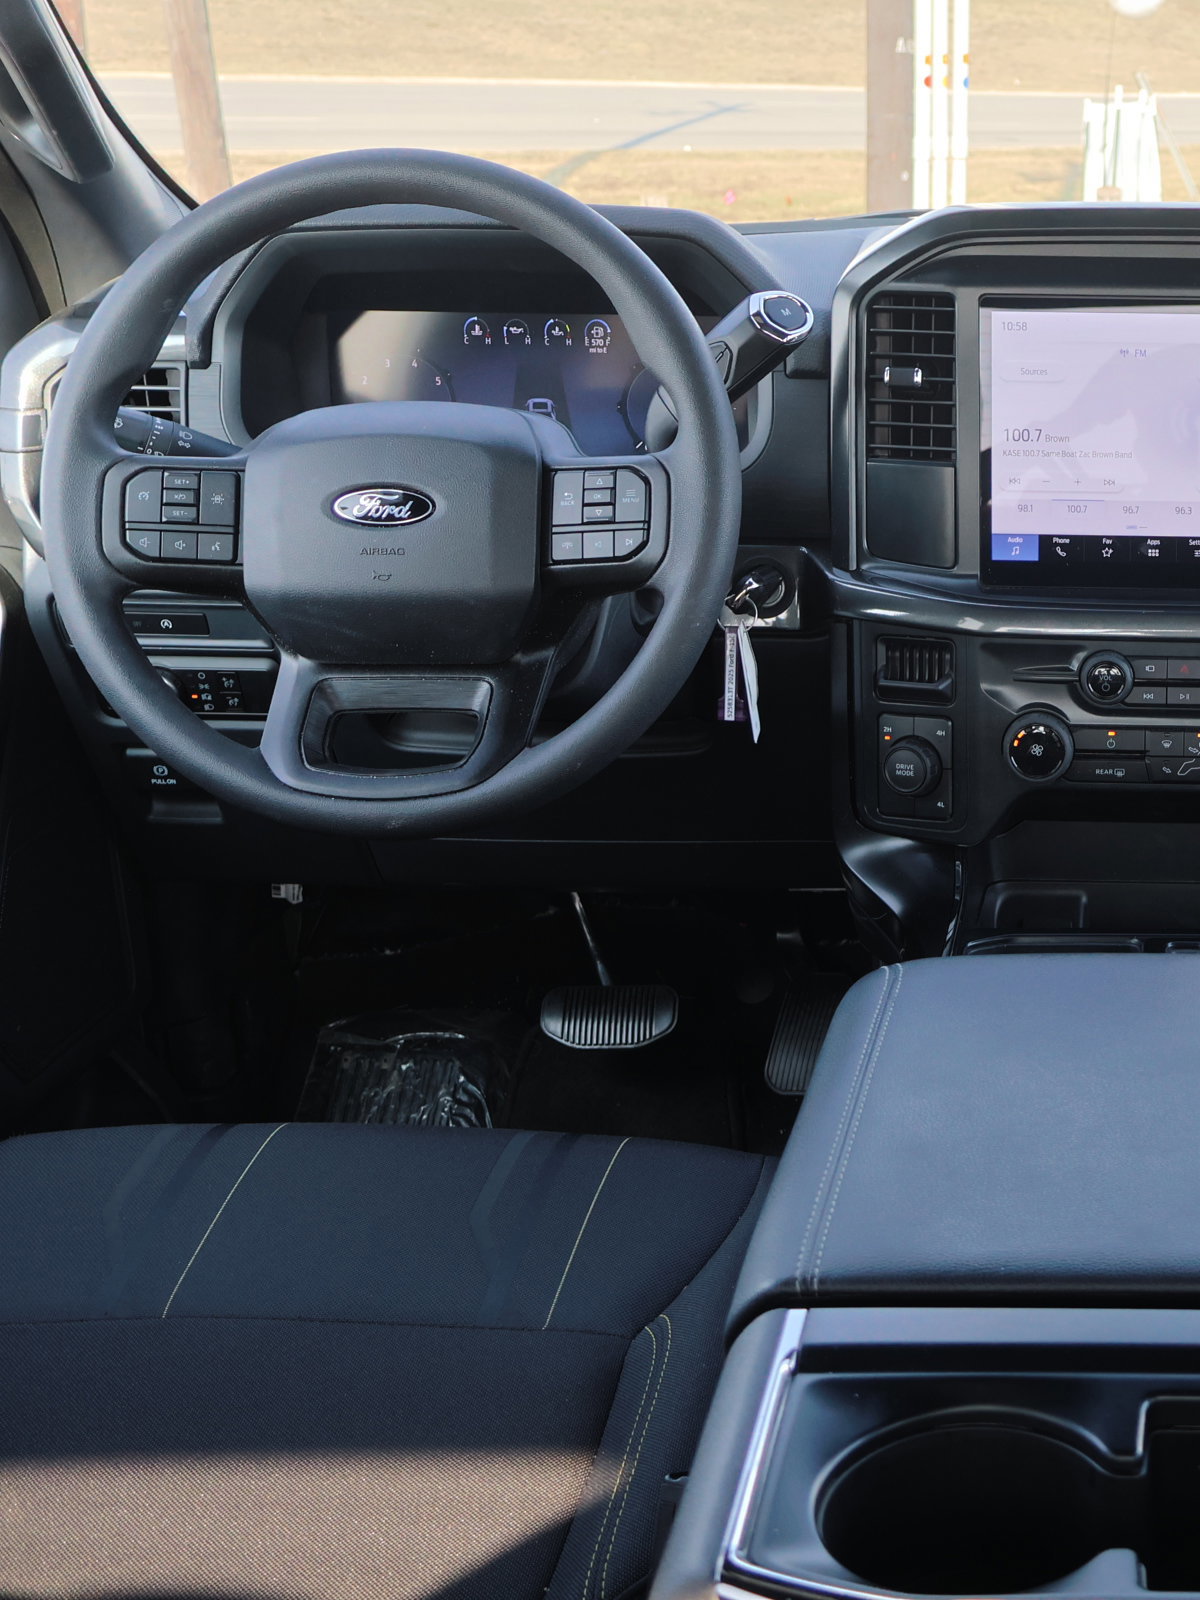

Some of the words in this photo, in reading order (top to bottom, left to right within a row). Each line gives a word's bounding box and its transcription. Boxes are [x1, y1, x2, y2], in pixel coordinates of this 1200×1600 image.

[1001, 321, 1028, 332] 10:58
[1134, 349, 1148, 358] FM
[411, 359, 418, 368] 4
[1020, 367, 1048, 376] Sources
[435, 376, 442, 386] 5
[1003, 428, 1043, 443] 100.7
[1044, 434, 1070, 443] Brown
[1002, 449, 1022, 458] KASE
[1022, 449, 1041, 458] 100.7
[1041, 450, 1061, 458] Same
[1061, 450, 1078, 458] Boat
[1078, 450, 1091, 458] Zac
[1092, 450, 1114, 459] Brown
[1114, 450, 1133, 459] Band
[352, 493, 414, 520] Ford
[1017, 504, 1034, 513] 98.1
[1067, 504, 1088, 514] 100.7
[1122, 505, 1140, 515] 96.7
[1174, 506, 1193, 515] 96.3
[1102, 537, 1113, 545] Fav
[1146, 538, 1161, 547] Apps
[360, 547, 406, 557] AIRBAG
[935, 729, 946, 737] 4H
[1095, 768, 1113, 776] REAR
